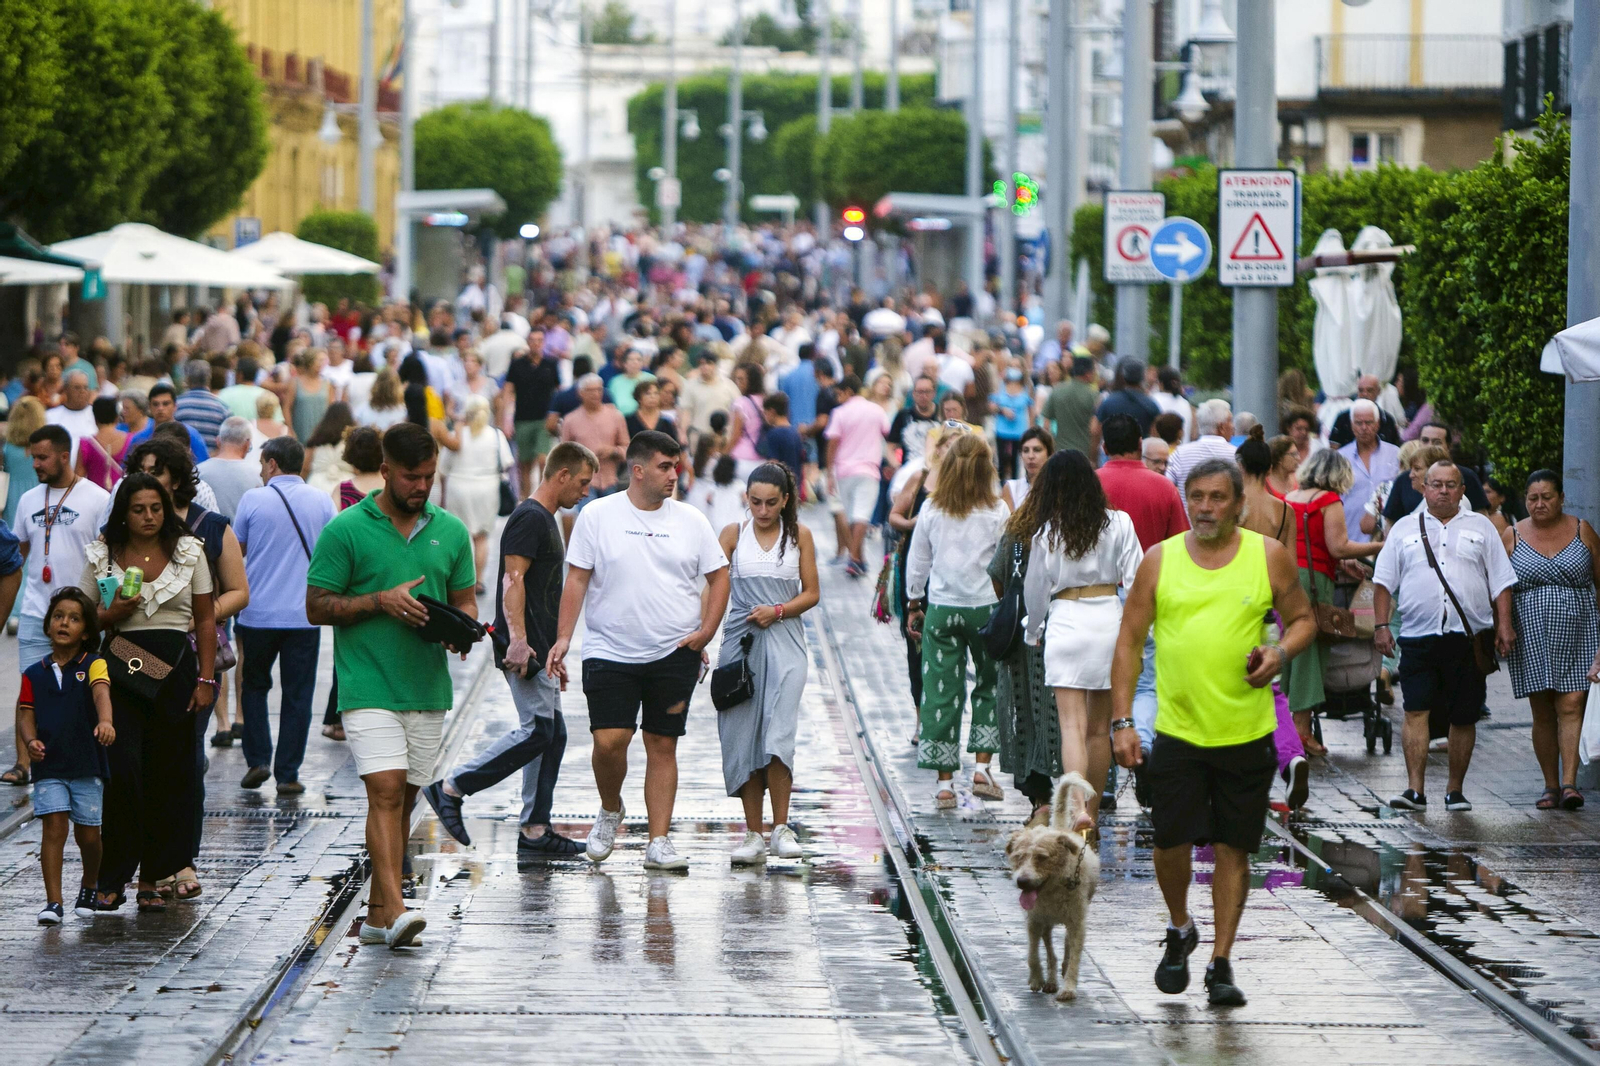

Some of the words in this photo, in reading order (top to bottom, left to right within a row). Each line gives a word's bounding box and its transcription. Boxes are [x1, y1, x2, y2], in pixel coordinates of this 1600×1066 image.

[1225, 175, 1291, 186] ATENCIÓN
[1226, 199, 1289, 207] CIRCULANDO
[1234, 273, 1253, 281] LAS
